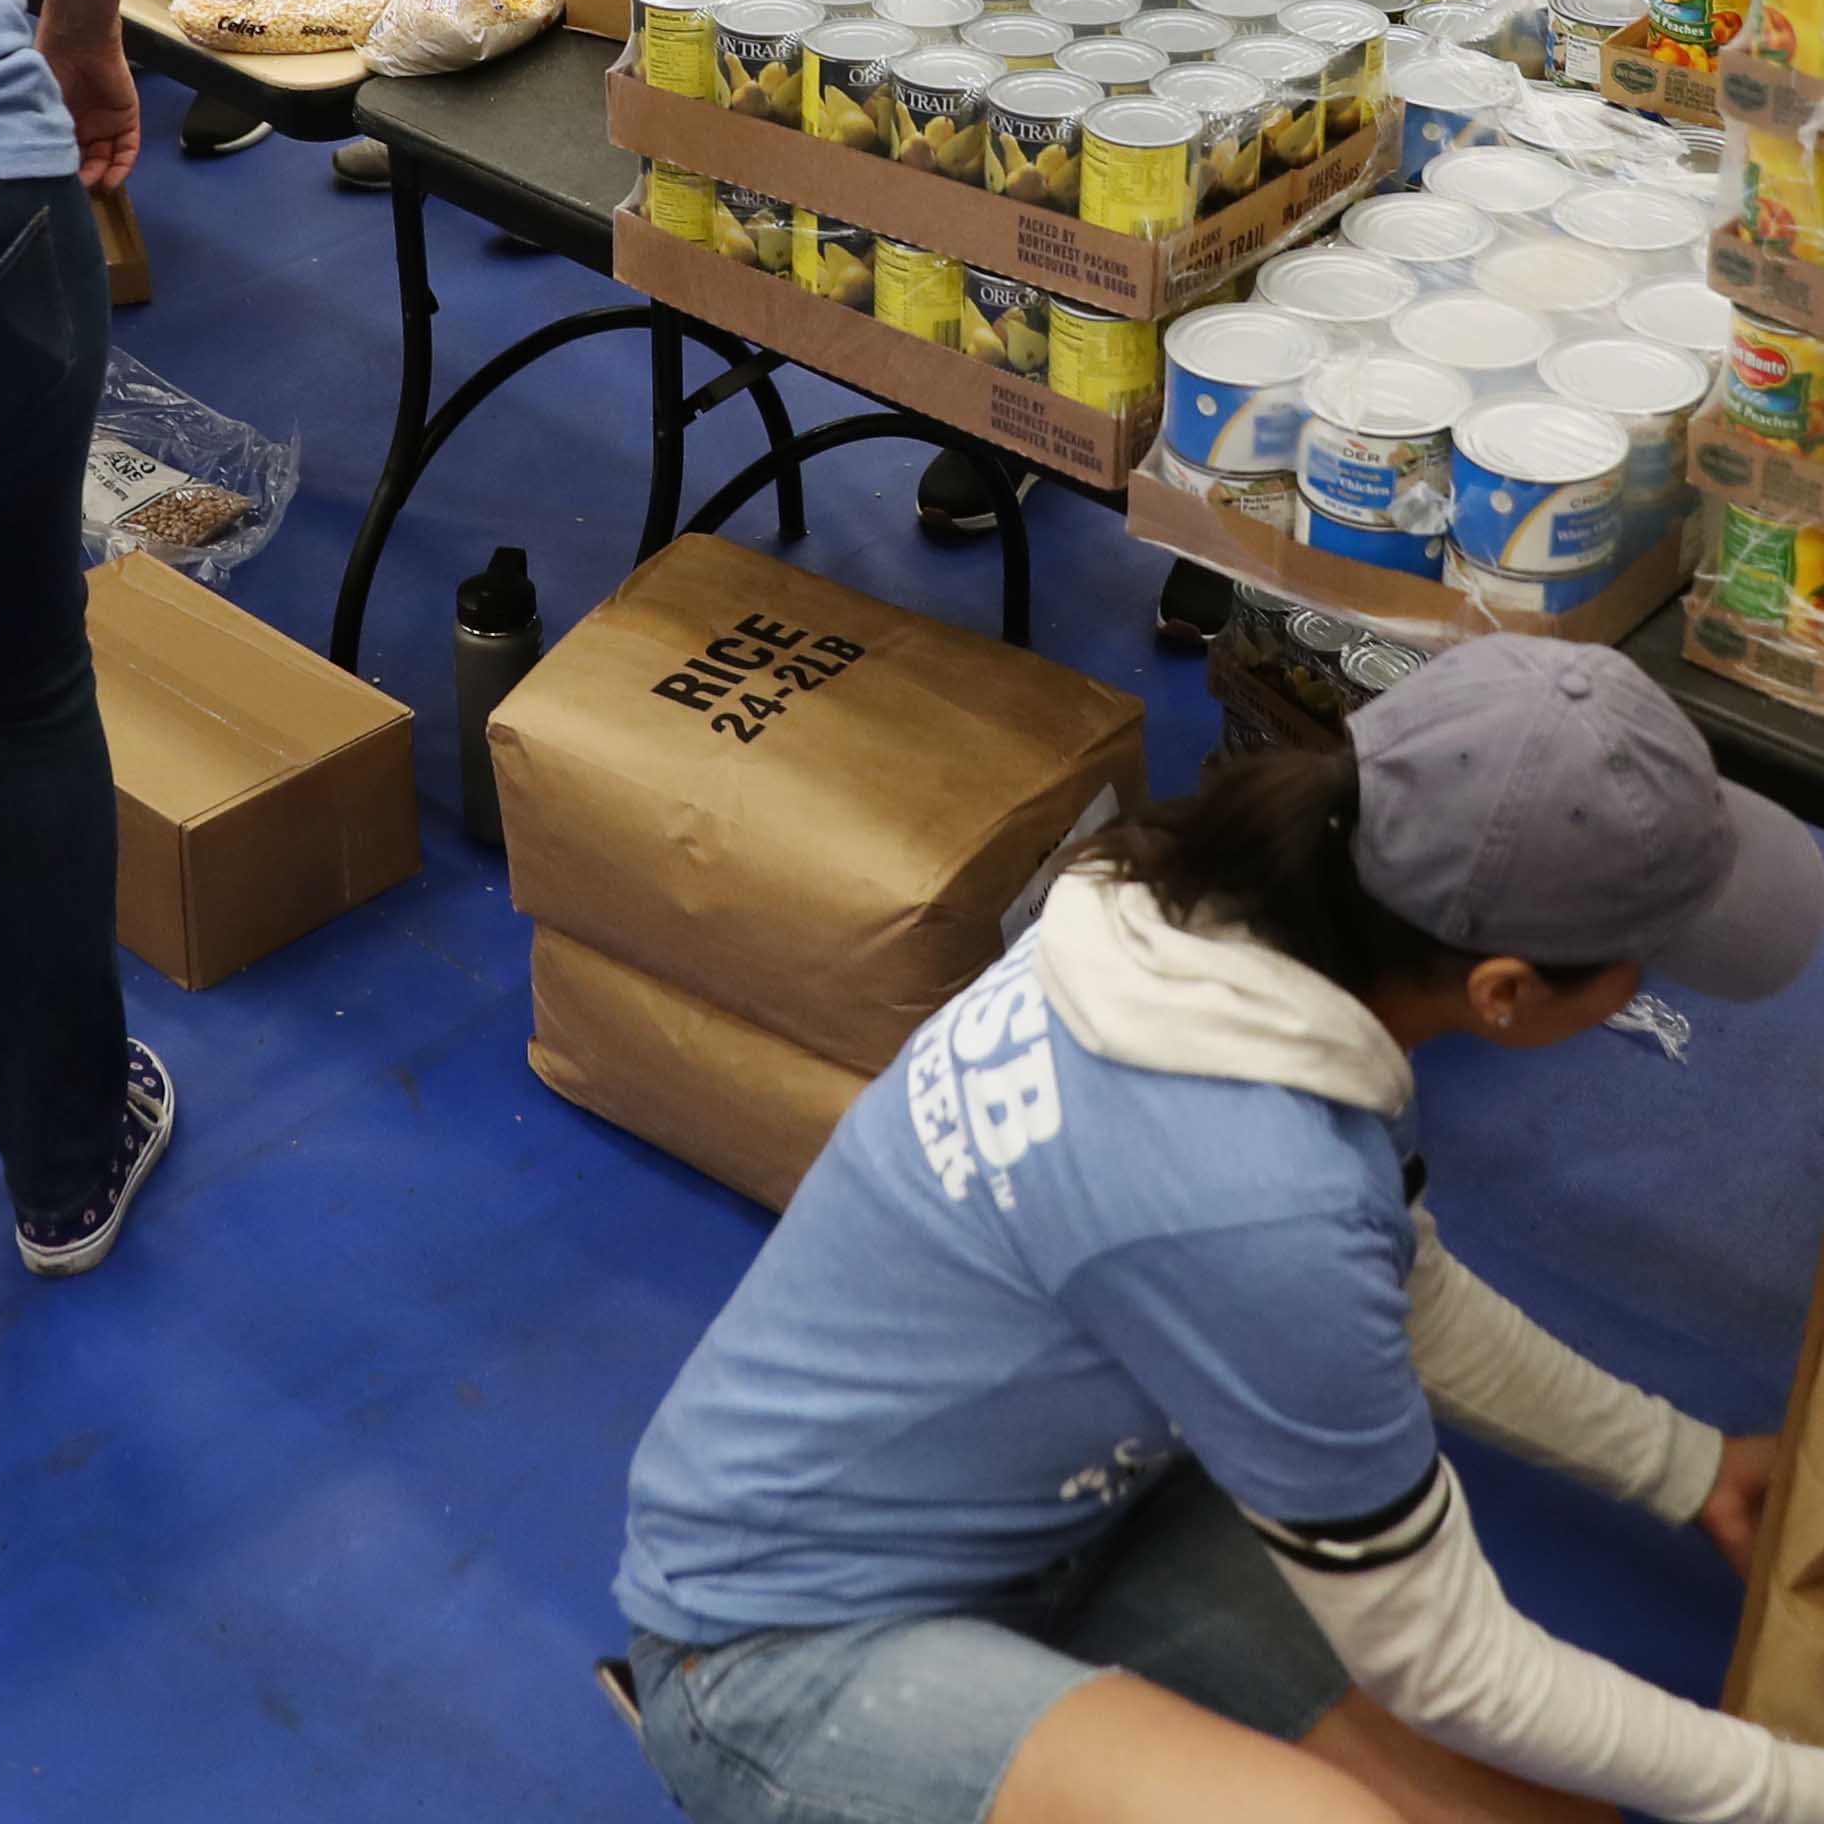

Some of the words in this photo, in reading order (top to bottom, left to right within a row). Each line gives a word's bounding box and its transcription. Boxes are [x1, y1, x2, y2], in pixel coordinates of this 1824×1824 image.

[1662, 16, 1705, 37] Peaches
[909, 90, 959, 113] TRAIL
[1018, 215, 1057, 237] PACKED
[1061, 226, 1076, 244] BY
[1228, 223, 1265, 263] TRAIL
[1017, 231, 1081, 263] NORTHWEST
[1083, 252, 1129, 278] PACKING
[1742, 351, 1786, 376] Monte
[991, 384, 1030, 408] PACKED
[1032, 396, 1046, 414] BY
[991, 399, 1051, 434] NORTHWEST
[1053, 423, 1095, 452] PACKING
[1743, 406, 1799, 429] Peaches
[1339, 476, 1390, 497] Chicken
[651, 613, 810, 712] RICE
[710, 634, 868, 744] 24-2LB
